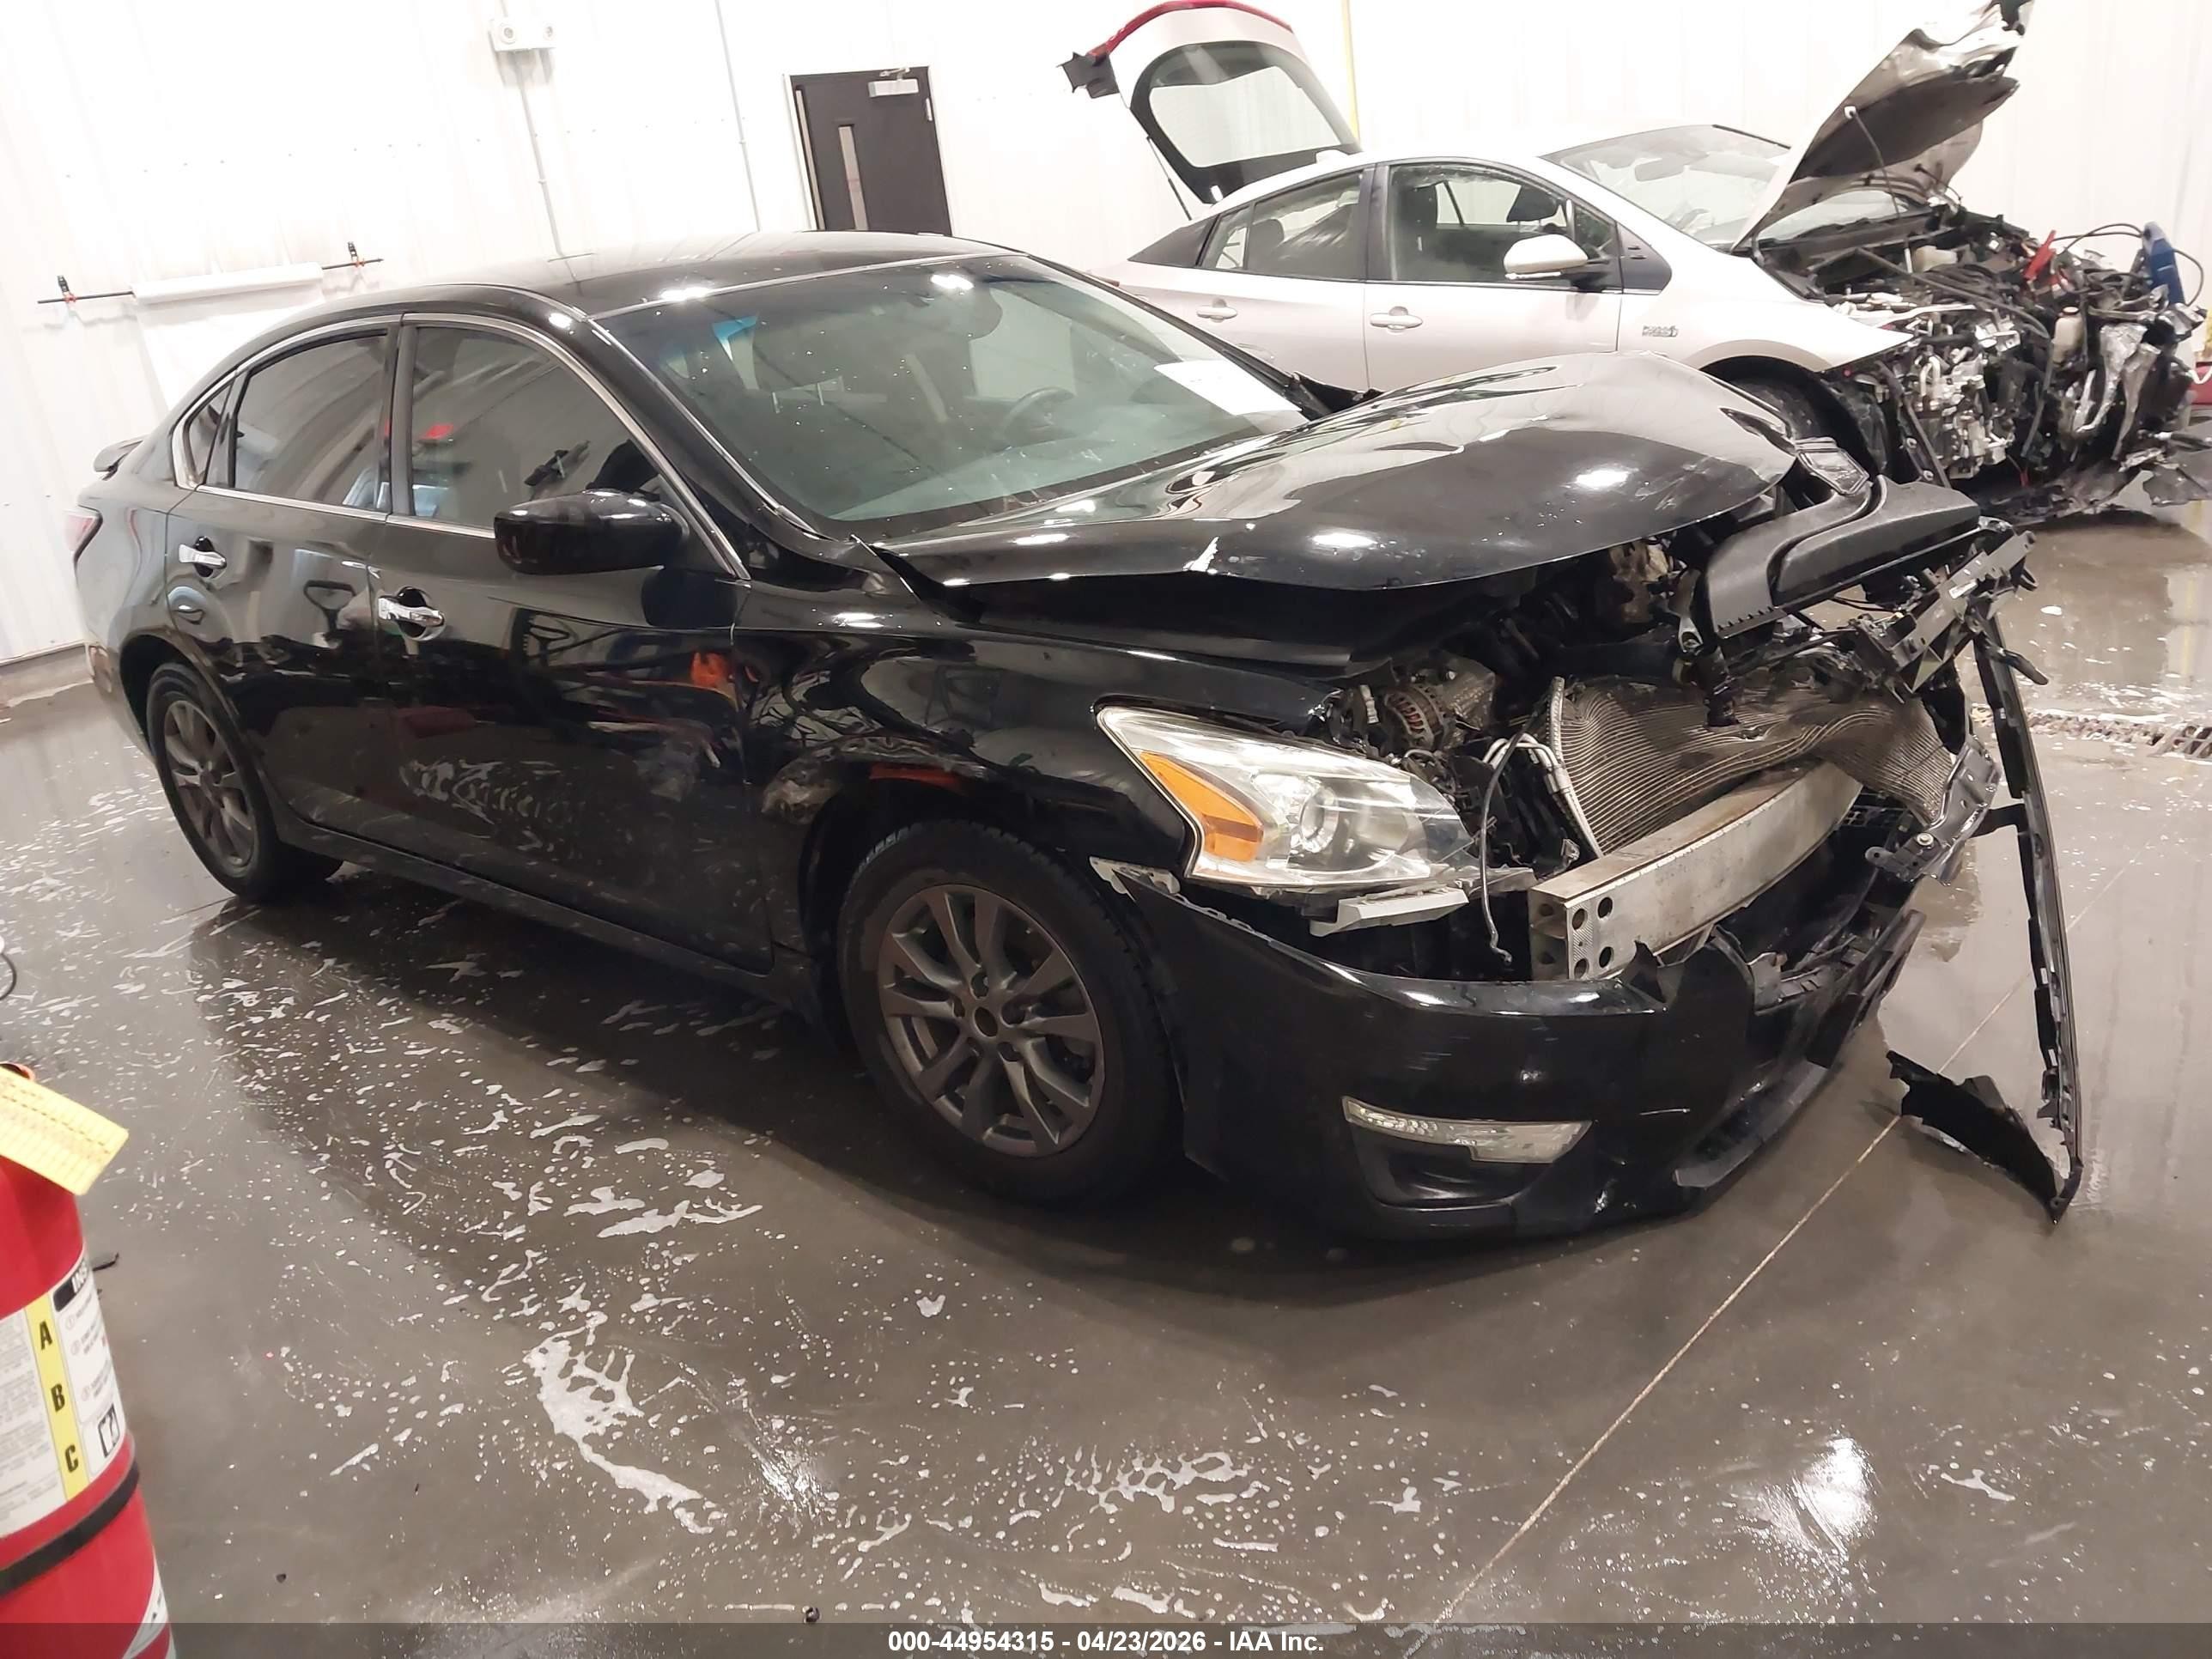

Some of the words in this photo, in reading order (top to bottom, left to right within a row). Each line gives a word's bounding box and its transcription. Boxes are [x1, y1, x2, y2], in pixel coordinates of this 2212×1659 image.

[40, 1320, 53, 1351] A
[51, 1383, 66, 1413] B
[64, 1444, 79, 1474] C
